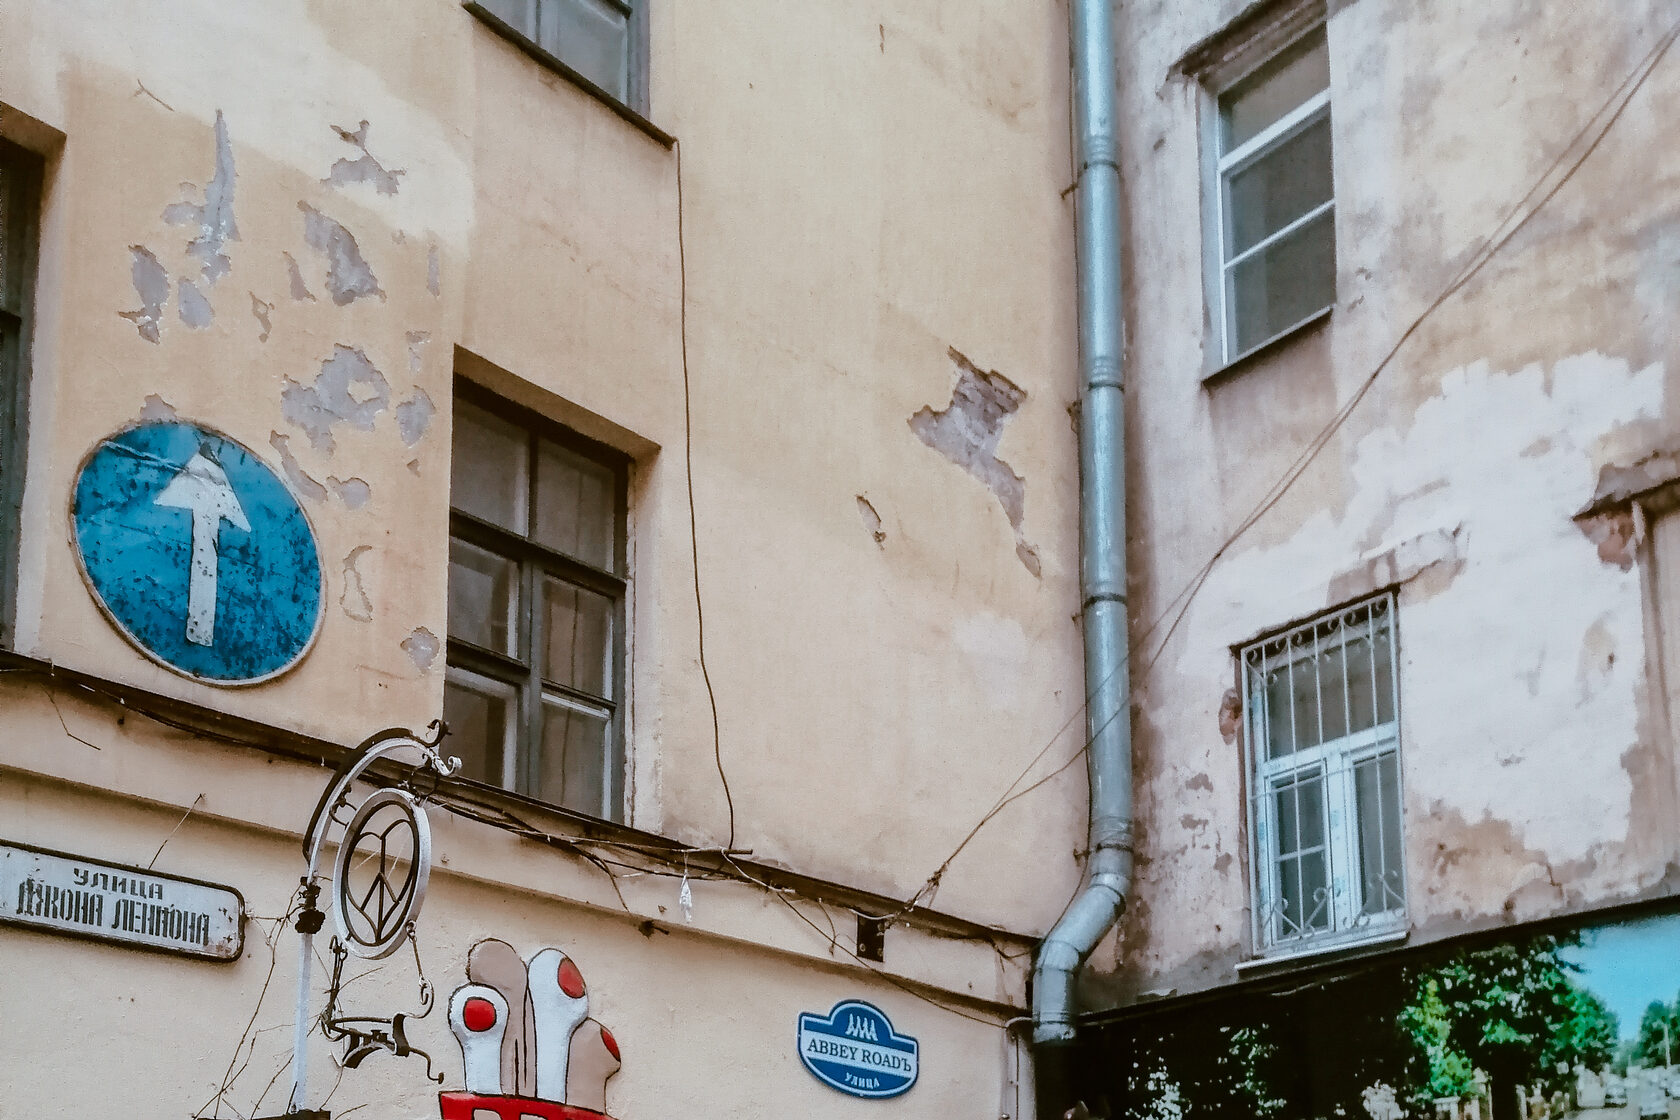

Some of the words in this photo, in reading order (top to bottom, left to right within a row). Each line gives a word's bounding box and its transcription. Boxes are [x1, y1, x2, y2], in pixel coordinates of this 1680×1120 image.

[73, 867, 164, 900] УЛИЦА
[111, 899, 210, 946] ЛЕННОНА
[807, 1038, 859, 1061] ABBEY
